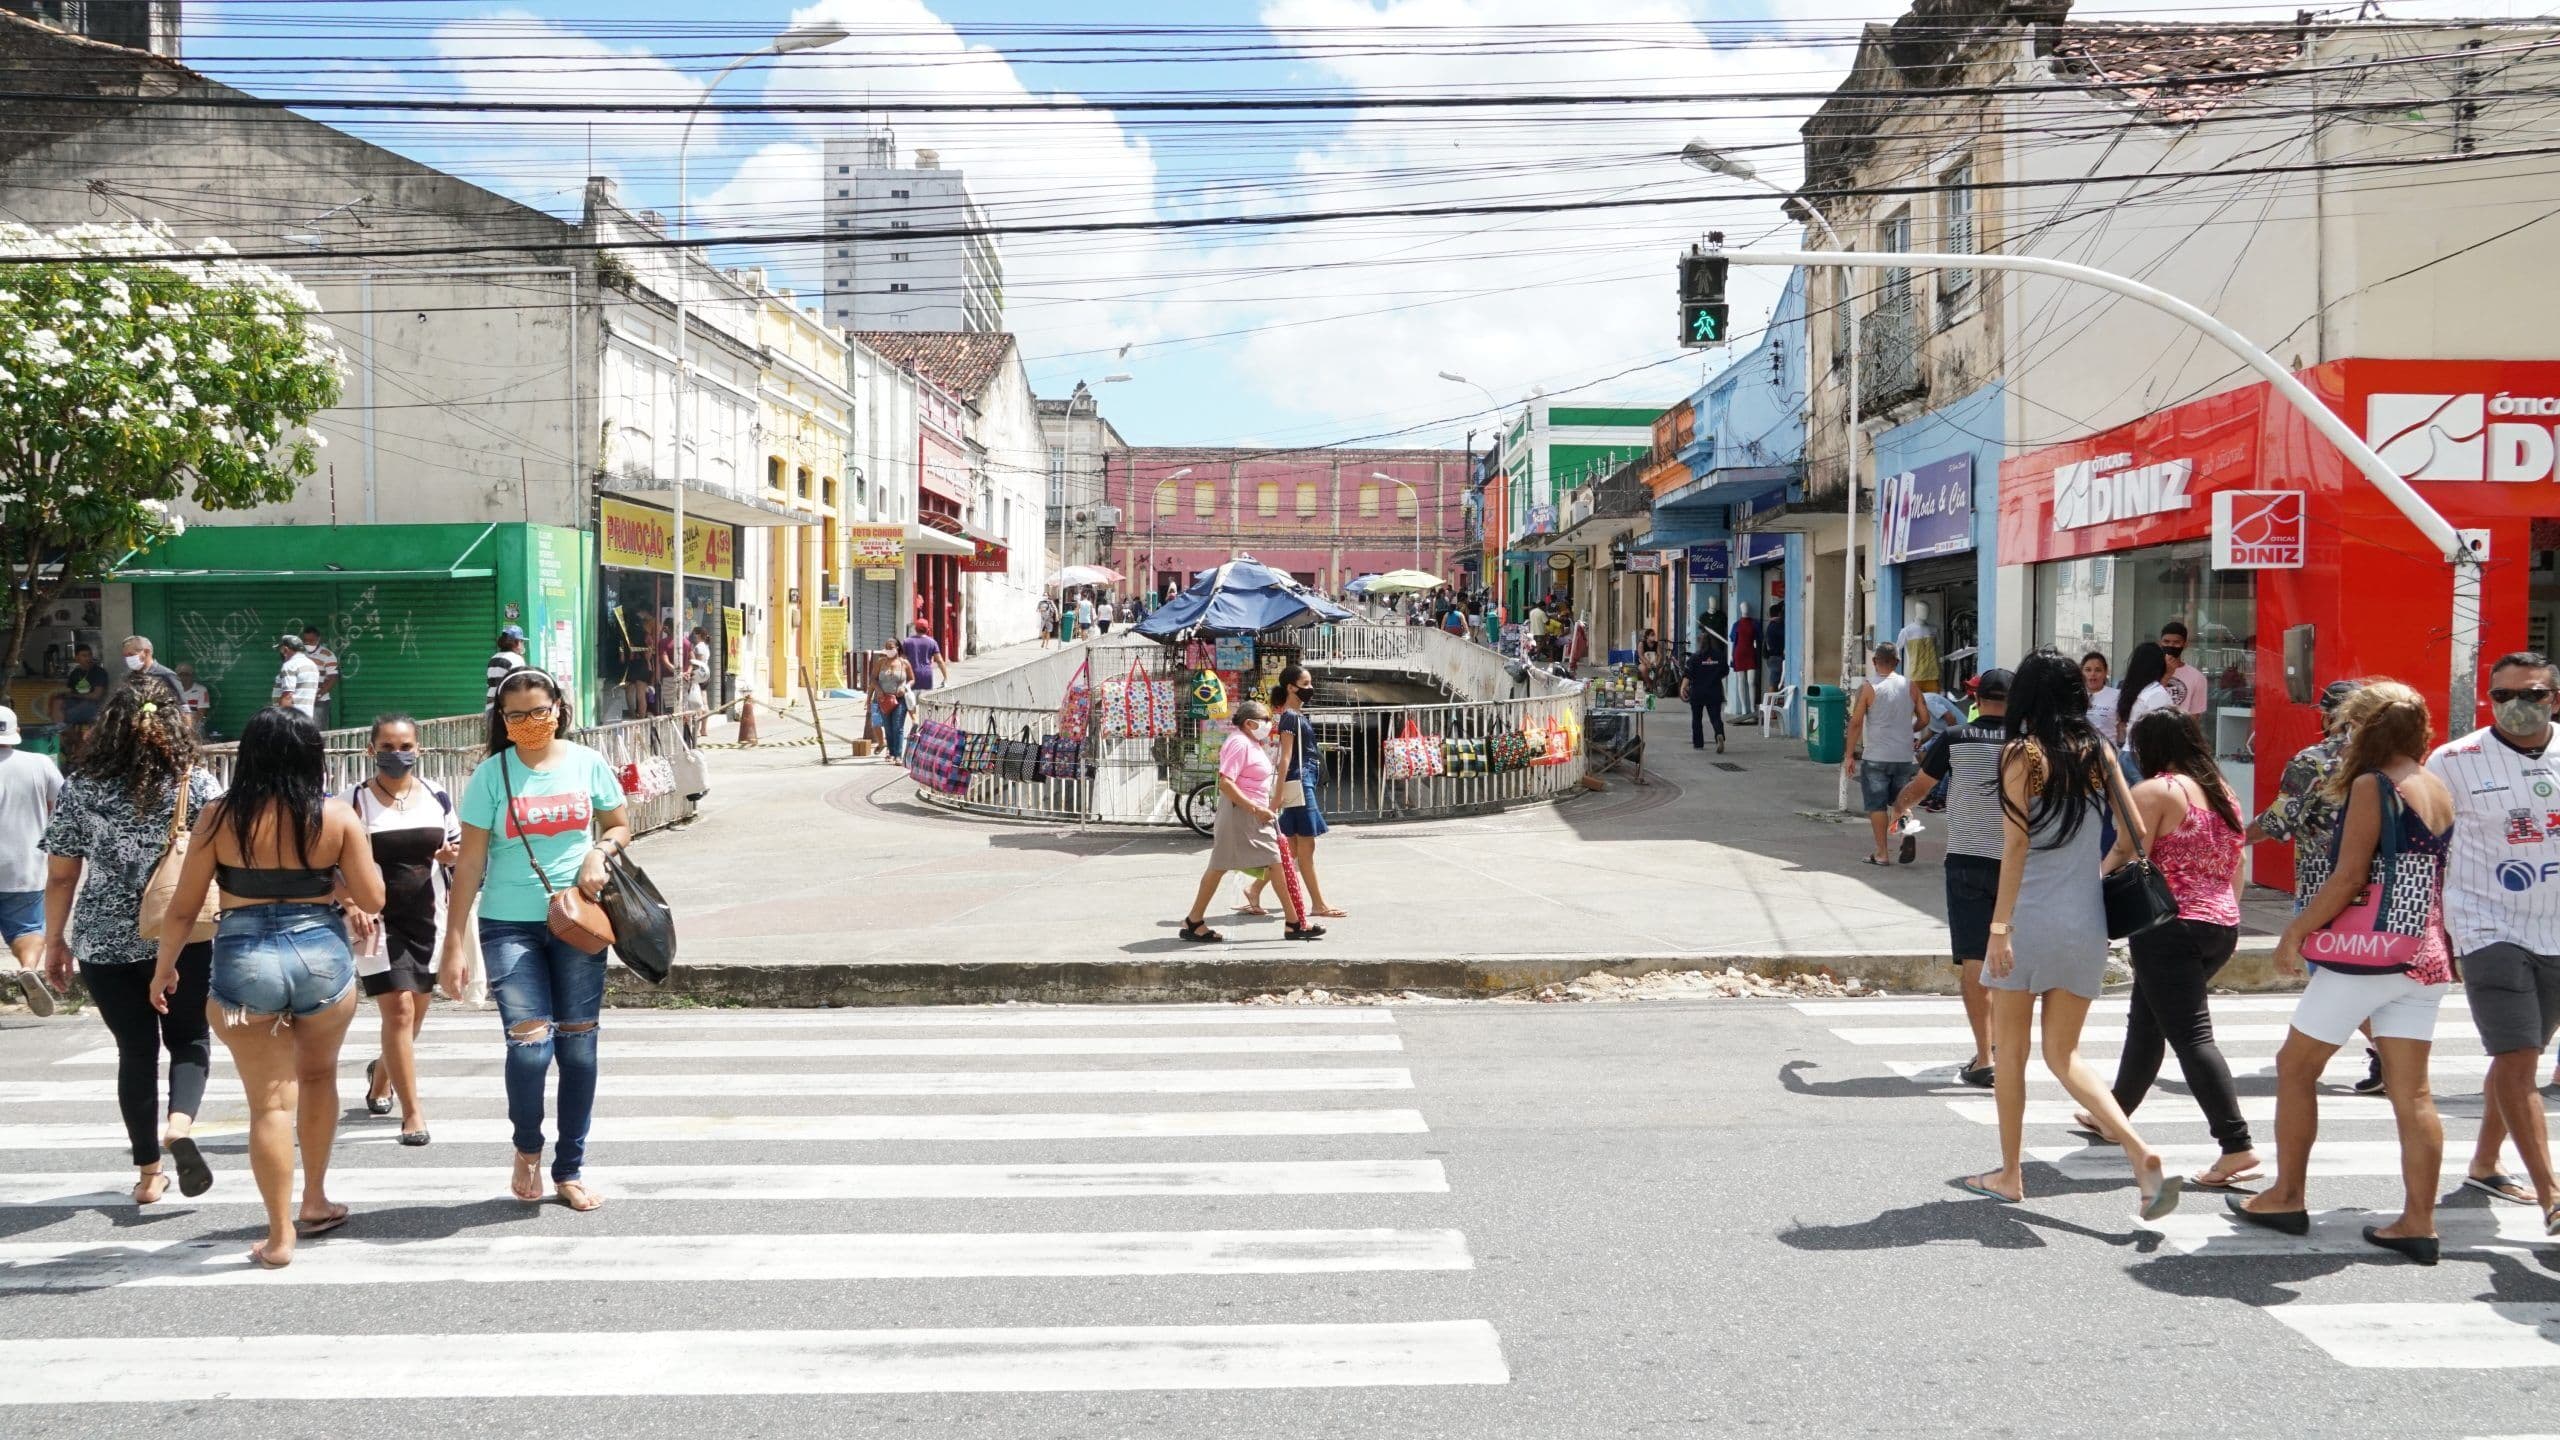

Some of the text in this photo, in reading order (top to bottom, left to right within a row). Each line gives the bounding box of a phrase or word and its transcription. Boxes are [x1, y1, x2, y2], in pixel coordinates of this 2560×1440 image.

[1910, 481, 1967, 521] Moda & Cia
[2091, 458, 2192, 522] DINIZ
[607, 515, 664, 565] PROMOÇÃO
[2231, 548, 2299, 564] DINIZ
[512, 802, 588, 826] Levi's
